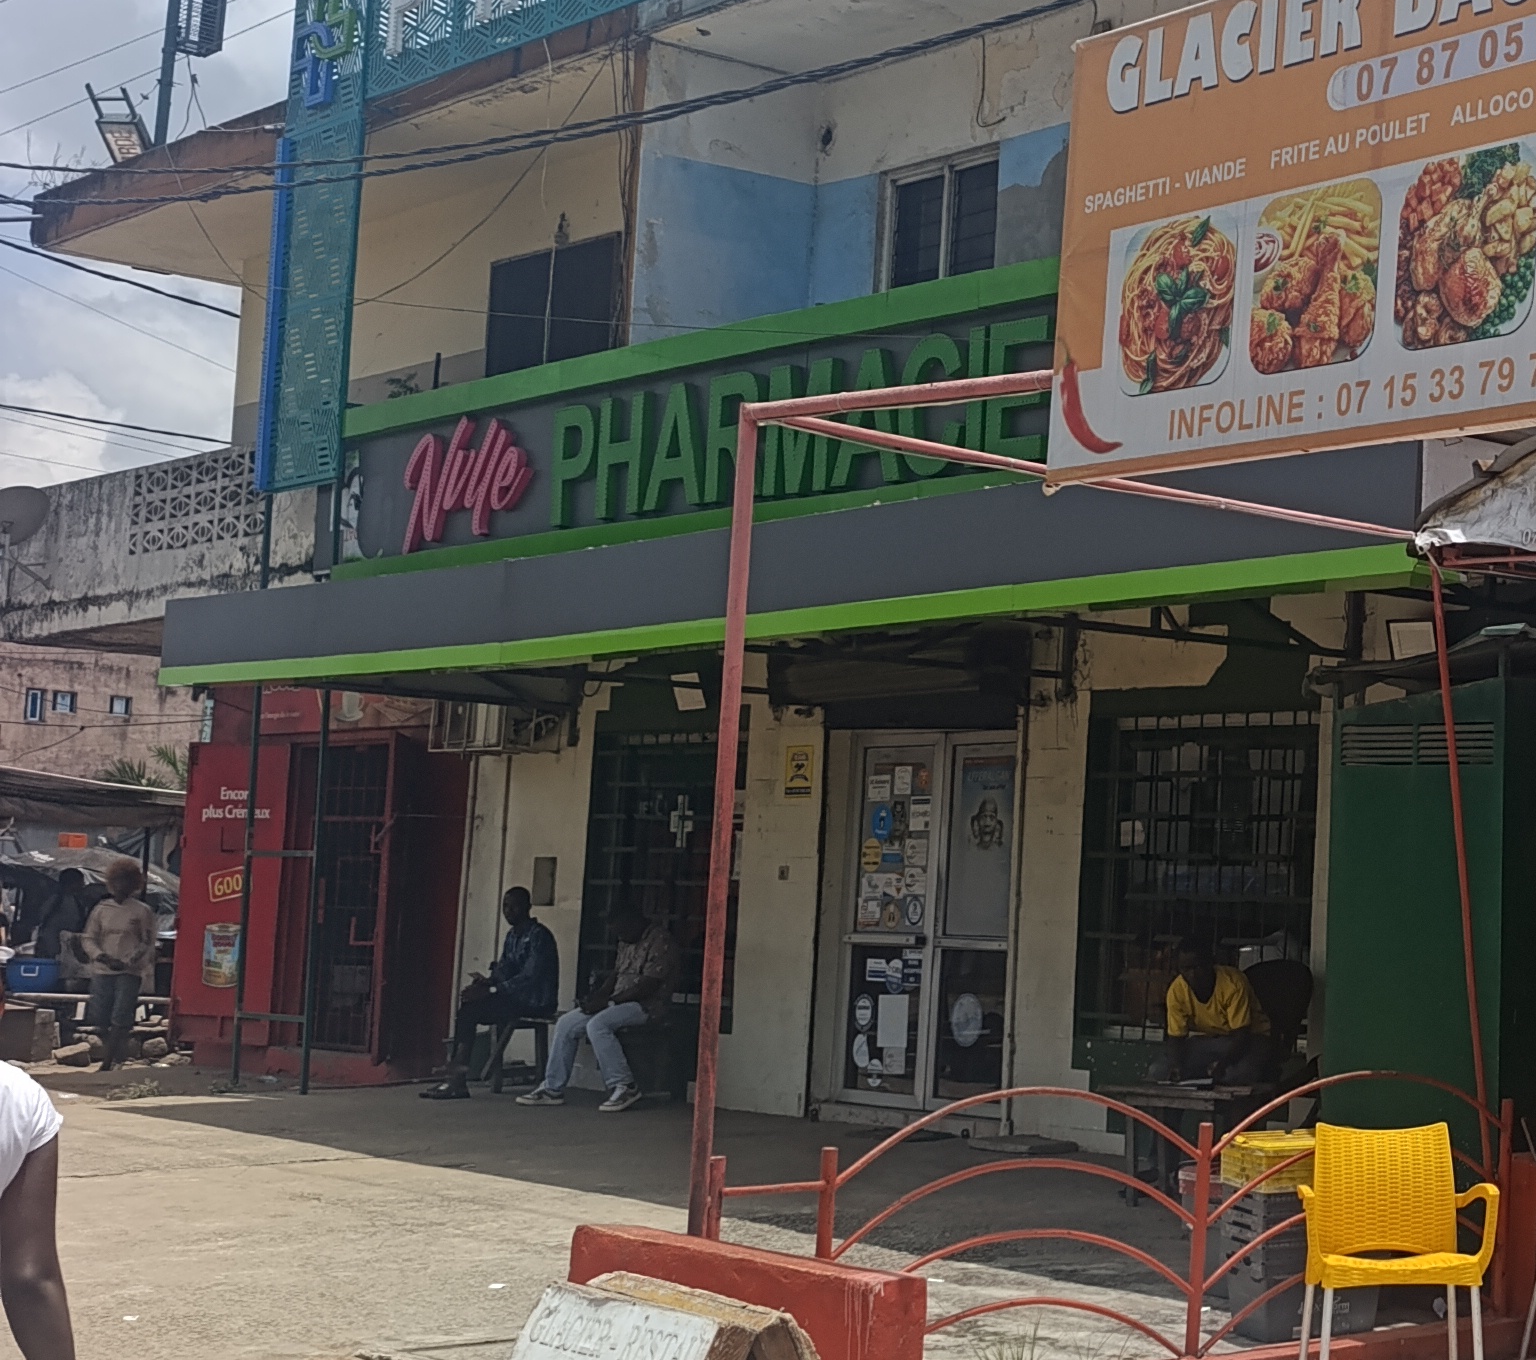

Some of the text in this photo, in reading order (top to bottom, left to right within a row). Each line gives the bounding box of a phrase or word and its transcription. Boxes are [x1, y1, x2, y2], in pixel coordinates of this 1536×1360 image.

[1356, 57, 1398, 101] 07
[1416, 40, 1460, 86] 87
[1478, 22, 1524, 69] 05
[1450, 87, 1534, 126] ALLOCO
[1270, 112, 1430, 170] FRITE AU POULET
[1084, 177, 1170, 214] SPAGHETTI
[1184, 158, 1246, 190] VIANDE
[550, 314, 1049, 529] PHARMACIE
[1168, 389, 1305, 441] INFOLINE
[1336, 379, 1371, 417] 07
[1383, 372, 1417, 409] 15
[1428, 365, 1465, 404] 33
[1478, 356, 1515, 396] 79
[202, 804, 224, 822] plus
[220, 786, 250, 800] Encor
